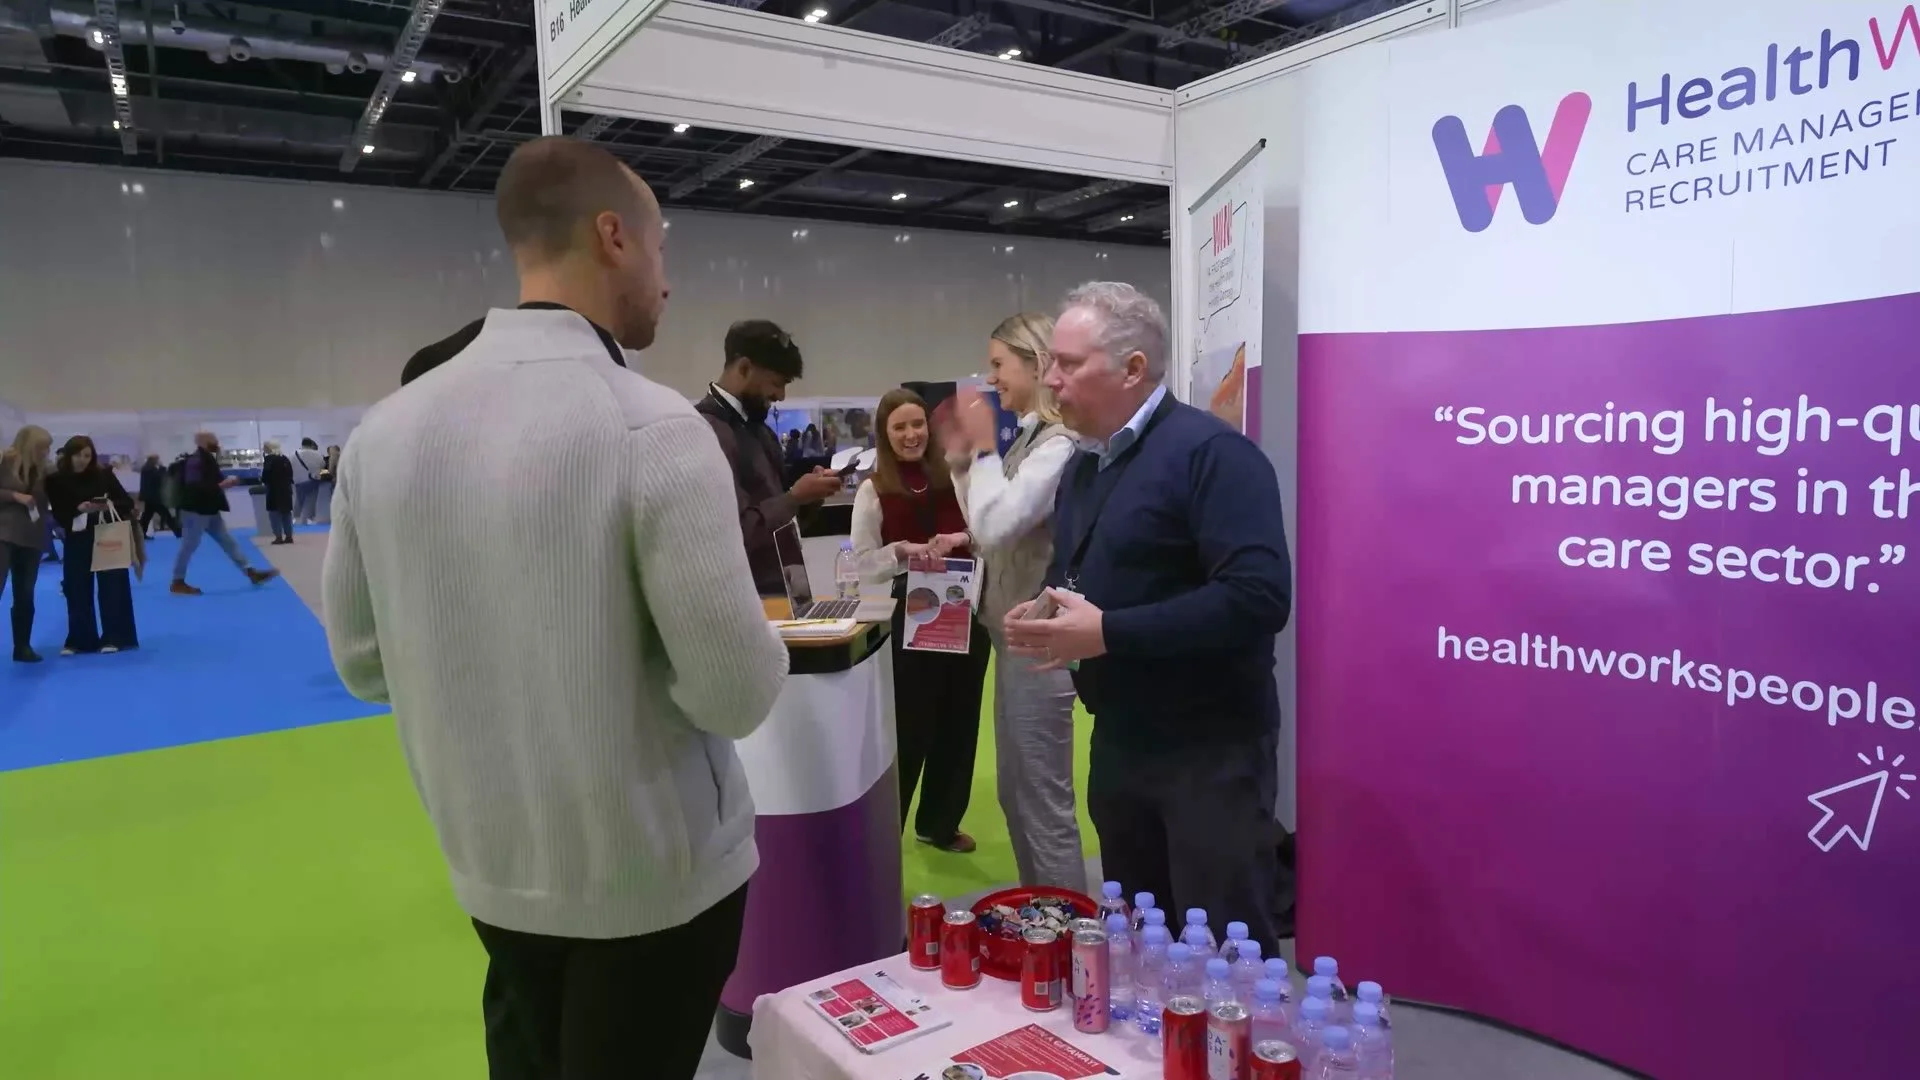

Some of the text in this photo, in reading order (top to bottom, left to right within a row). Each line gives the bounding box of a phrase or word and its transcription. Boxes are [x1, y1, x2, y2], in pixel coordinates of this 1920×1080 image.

[550, 0, 592, 42] B16 Hea
[1626, 88, 1920, 176] CARE MANAGE
[1626, 138, 1897, 213] RECRUITMENT
[1434, 402, 1685, 455] “Sourcing
[1512, 473, 1776, 520] managers
[1797, 467, 1847, 516] in
[1558, 536, 1906, 594] care sector.”
[1437, 626, 1920, 731] healthworkspeople
